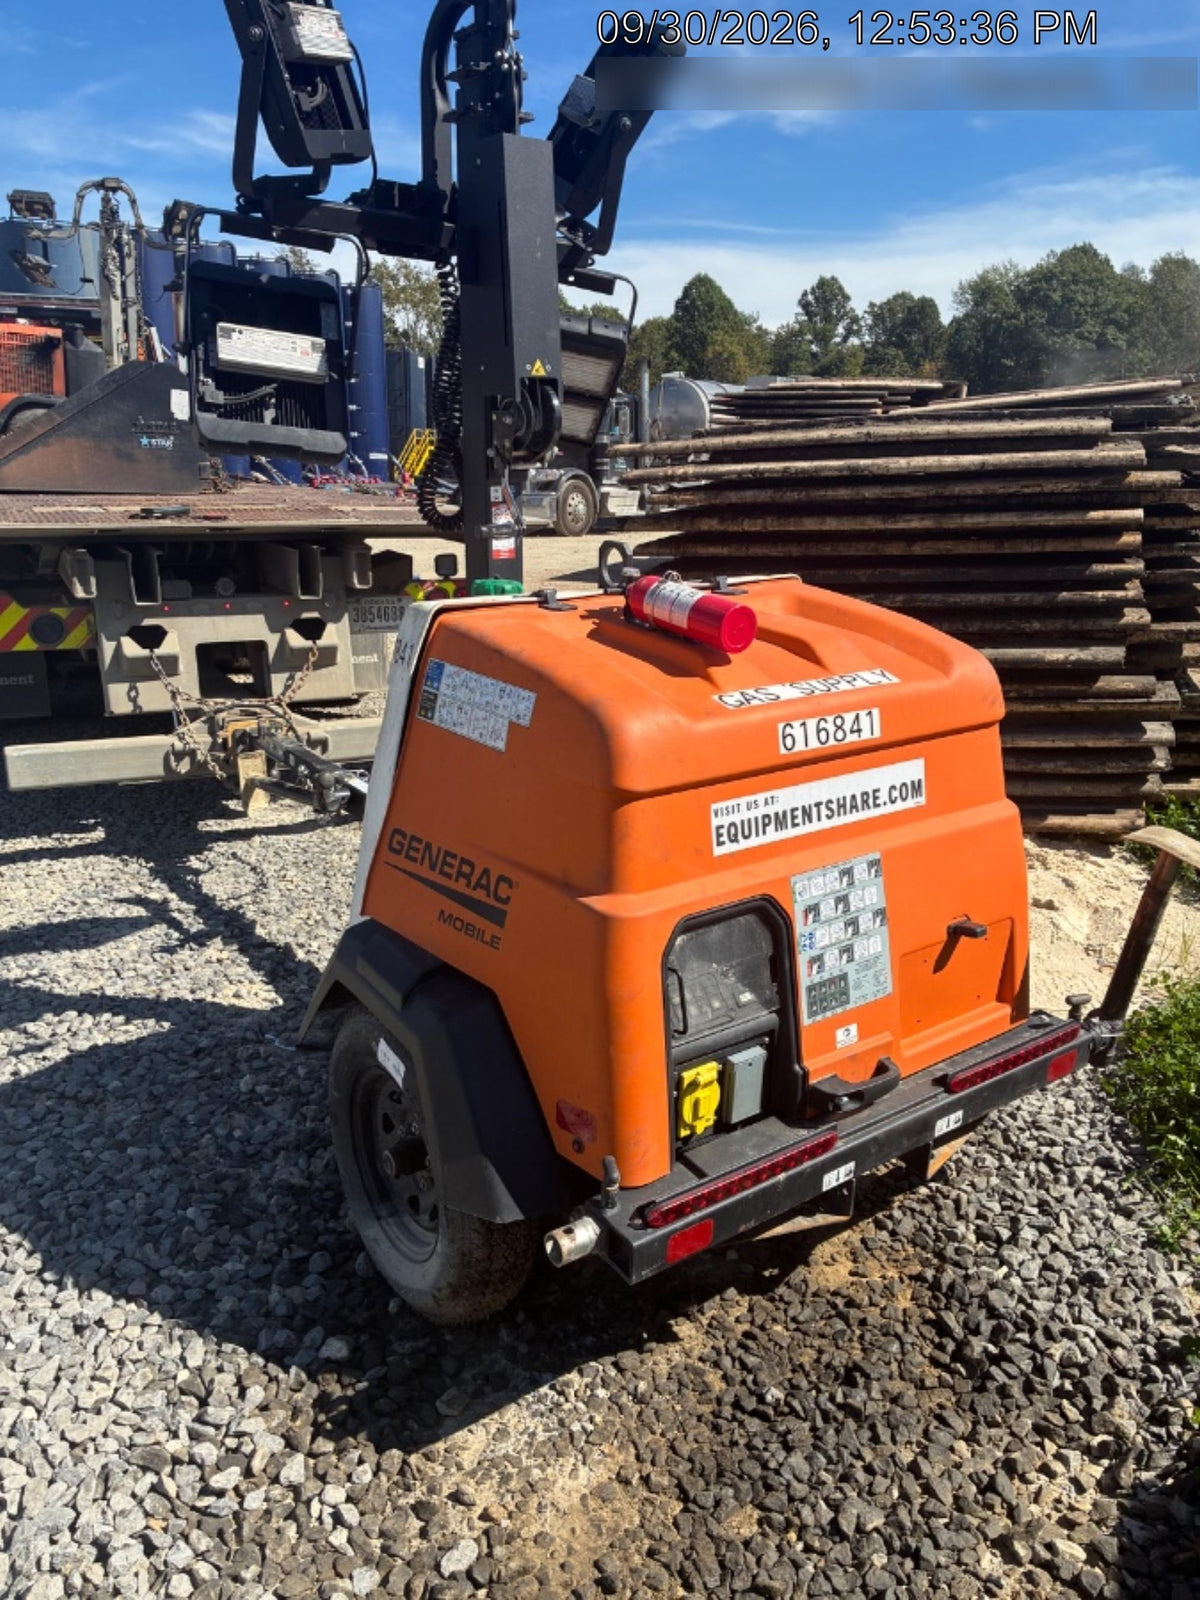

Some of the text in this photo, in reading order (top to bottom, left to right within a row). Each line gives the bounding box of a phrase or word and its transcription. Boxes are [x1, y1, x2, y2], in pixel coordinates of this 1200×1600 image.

[717, 670, 894, 709] GAS SUPPLY
[781, 710, 876, 751] 616841
[713, 796, 779, 819] VISIT US AT:
[715, 778, 923, 847] EQUIPMENTSHARE.COM
[387, 827, 513, 906] GENERAC
[437, 908, 502, 951] MOBILE
